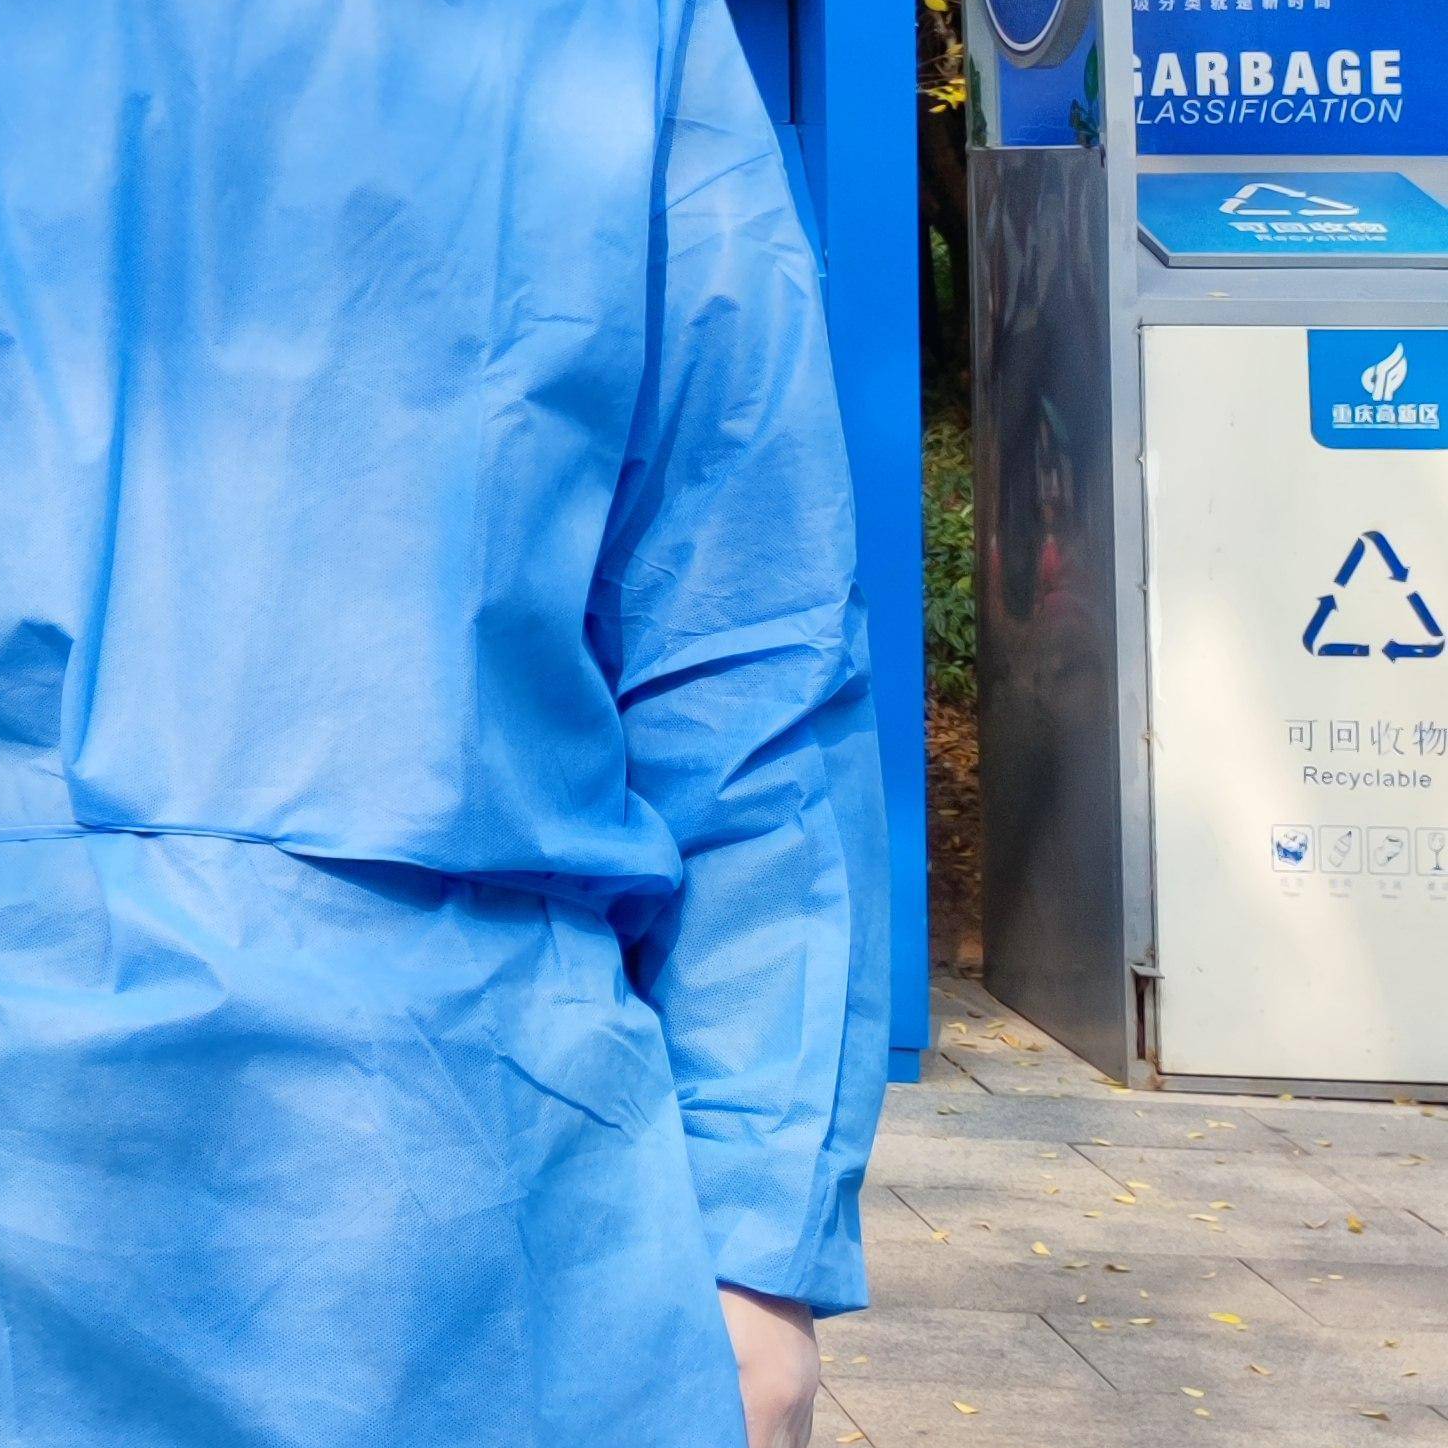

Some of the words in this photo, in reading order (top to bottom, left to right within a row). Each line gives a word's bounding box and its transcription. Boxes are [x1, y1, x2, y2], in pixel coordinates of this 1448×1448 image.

[1136, 98, 1403, 125] LASSIFICATION
[1332, 403, 1440, 425] 重庆高新区
[1284, 719, 1448, 756] 可回收物
[1303, 766, 1432, 790] Recyclable
